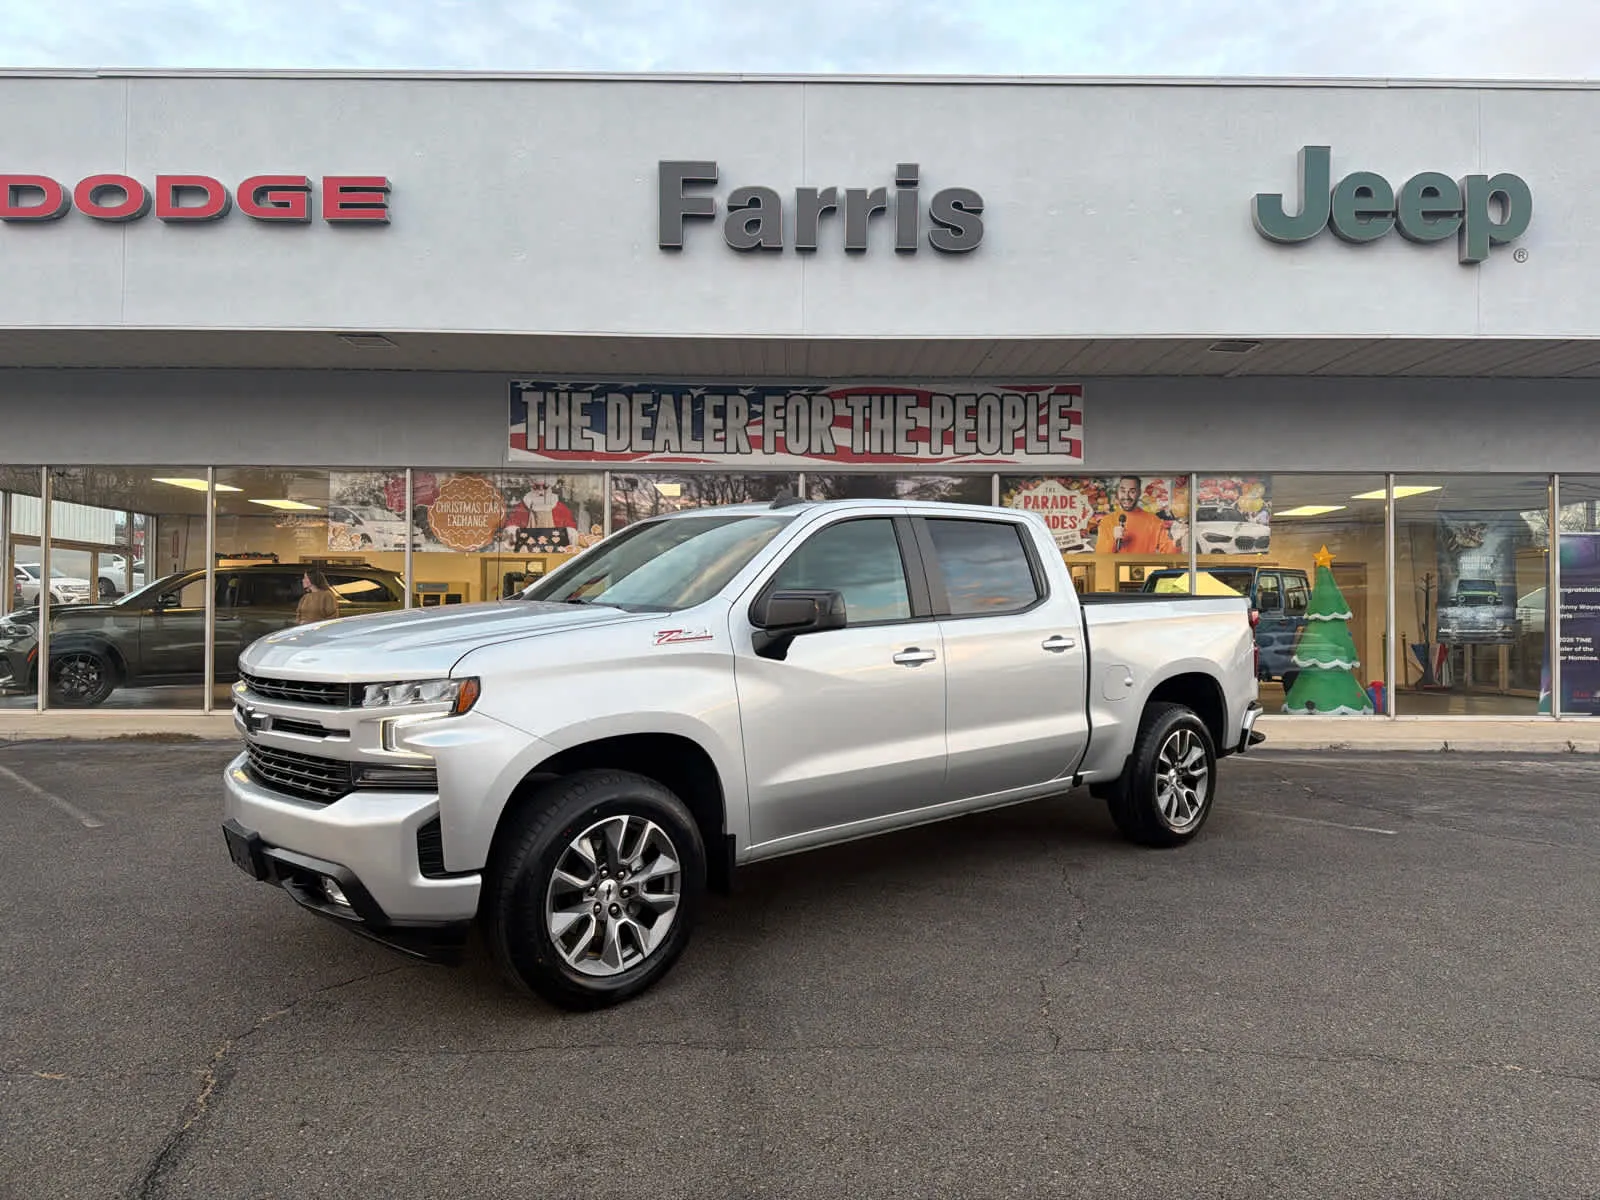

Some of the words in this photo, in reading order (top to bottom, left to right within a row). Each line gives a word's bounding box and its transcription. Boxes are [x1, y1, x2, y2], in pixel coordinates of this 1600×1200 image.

[0, 174, 391, 223] DODGE
[658, 160, 985, 252] Farris
[1251, 145, 1532, 264] Jeep
[520, 390, 595, 452] THE
[604, 392, 753, 454] DEALER
[761, 393, 836, 455] FOR
[847, 393, 919, 455] THE
[929, 393, 1073, 455] PEOPLE
[435, 500, 481, 514] CHRISTMAS
[483, 501, 499, 514] CAR
[1023, 495, 1078, 509] PARADE
[447, 514, 489, 528] EXCHANGE
[1044, 515, 1078, 529] ADES
